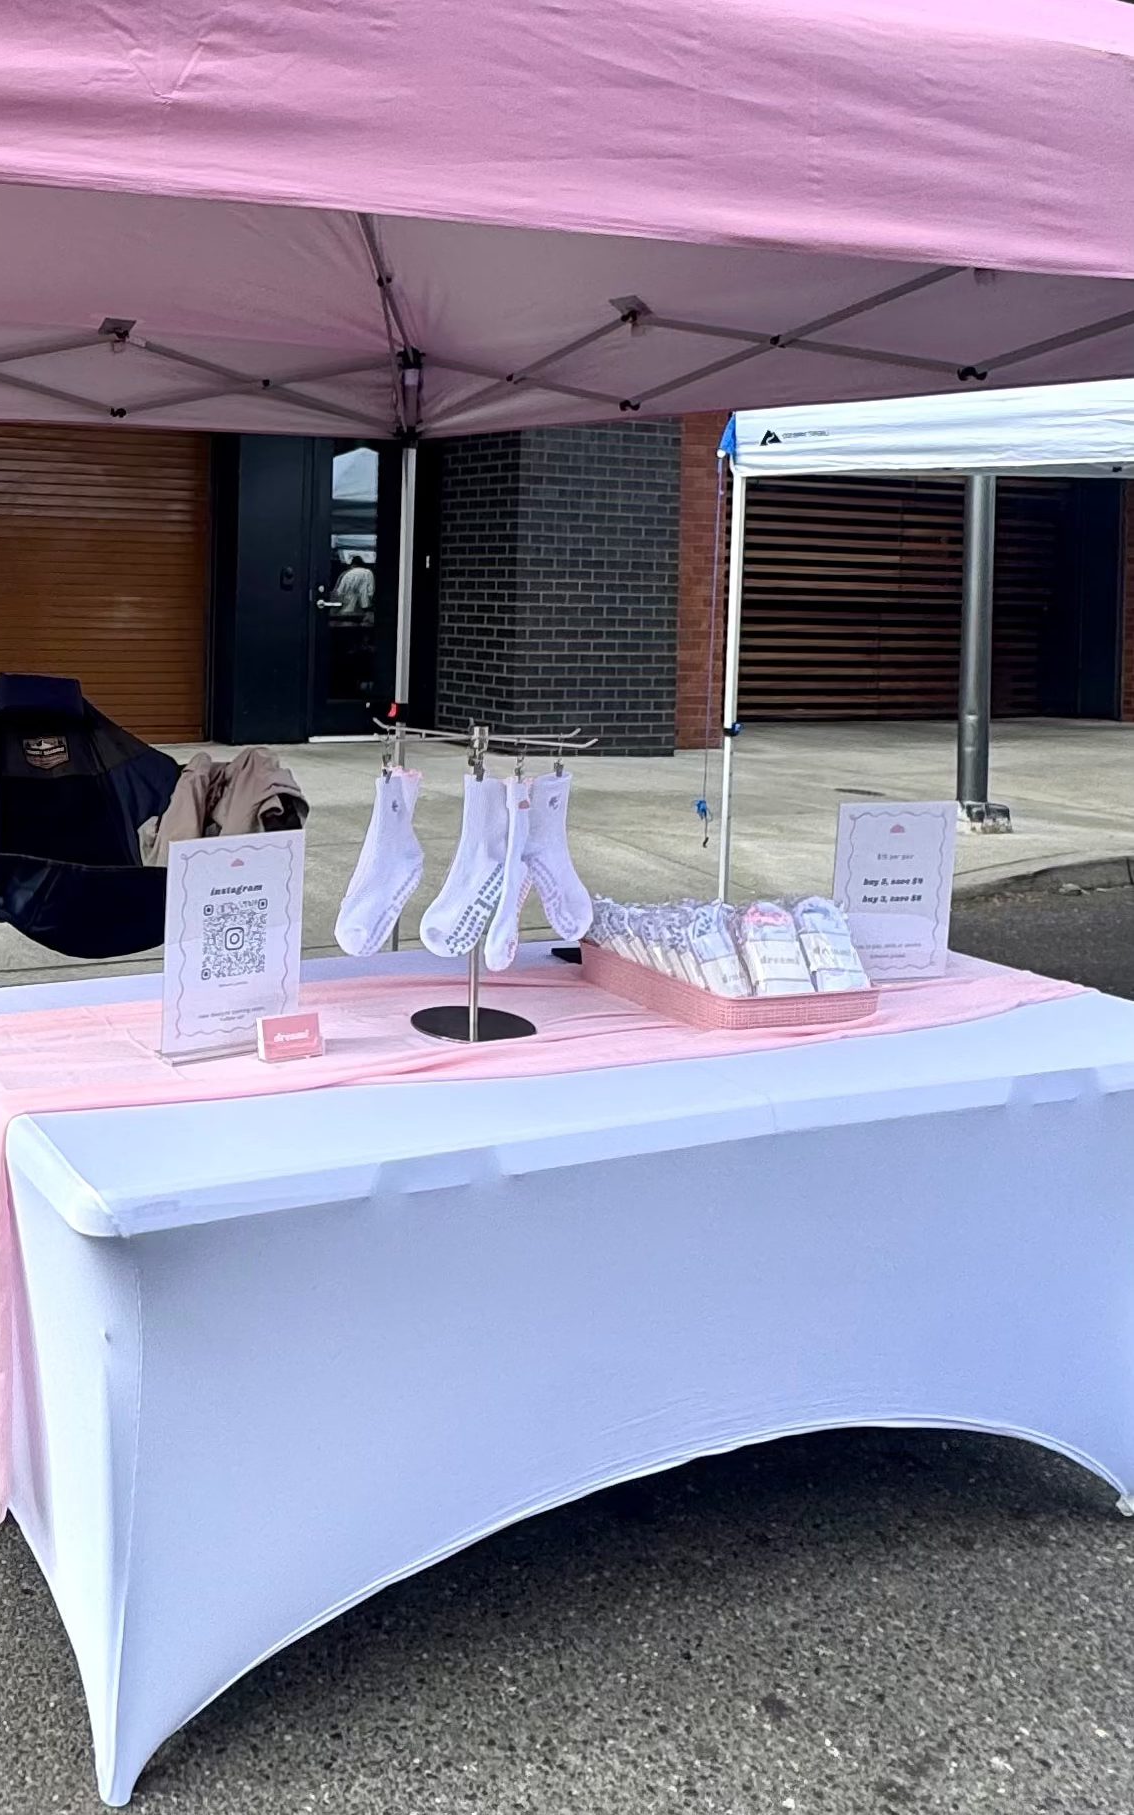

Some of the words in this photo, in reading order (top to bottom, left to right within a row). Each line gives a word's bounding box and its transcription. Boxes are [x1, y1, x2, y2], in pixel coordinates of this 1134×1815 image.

[863, 878, 879, 887] buy
[210, 884, 263, 896] instagram
[862, 895, 878, 904] buy
